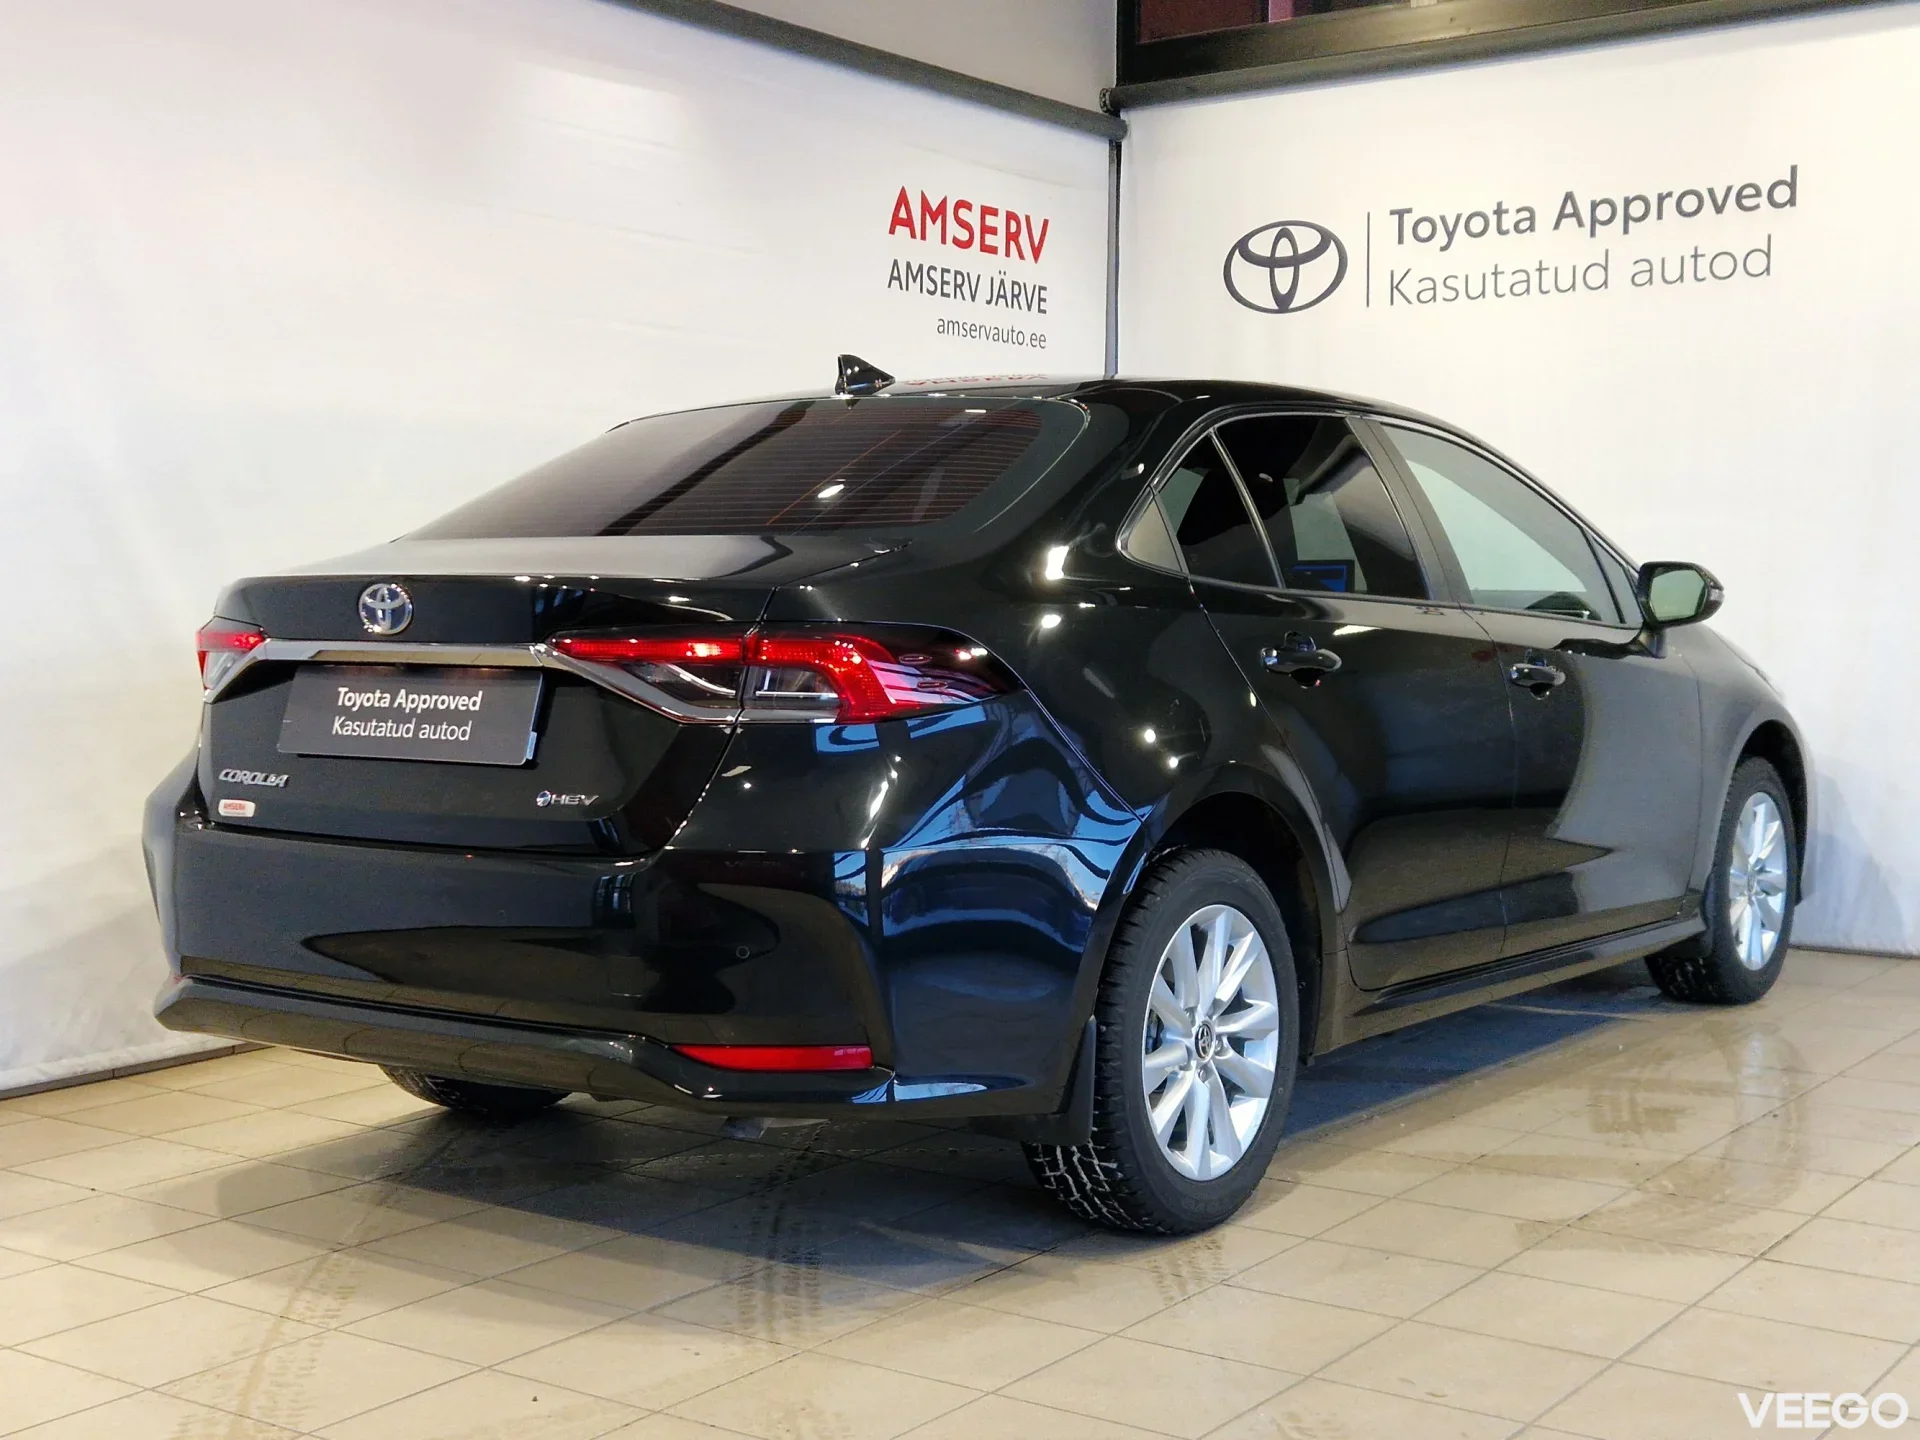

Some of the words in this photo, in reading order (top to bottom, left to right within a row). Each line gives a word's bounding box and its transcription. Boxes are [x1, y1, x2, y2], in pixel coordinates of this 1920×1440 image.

[1389, 200, 1537, 252] Toyota
[1553, 164, 1799, 239] Approved
[888, 185, 1050, 264] AMSERV
[887, 258, 981, 303] AMSERV
[985, 270, 1048, 314] JÄRVE
[1389, 248, 1610, 307] Kasutatud
[1631, 233, 1772, 288] autod
[937, 317, 1047, 349] amservauto.ee
[337, 686, 391, 712] Toyota
[393, 688, 483, 714] Approved
[332, 715, 416, 738] Kasutatud
[418, 720, 473, 741] autod
[218, 768, 289, 788] COROLLA
[550, 794, 600, 806] HEV
